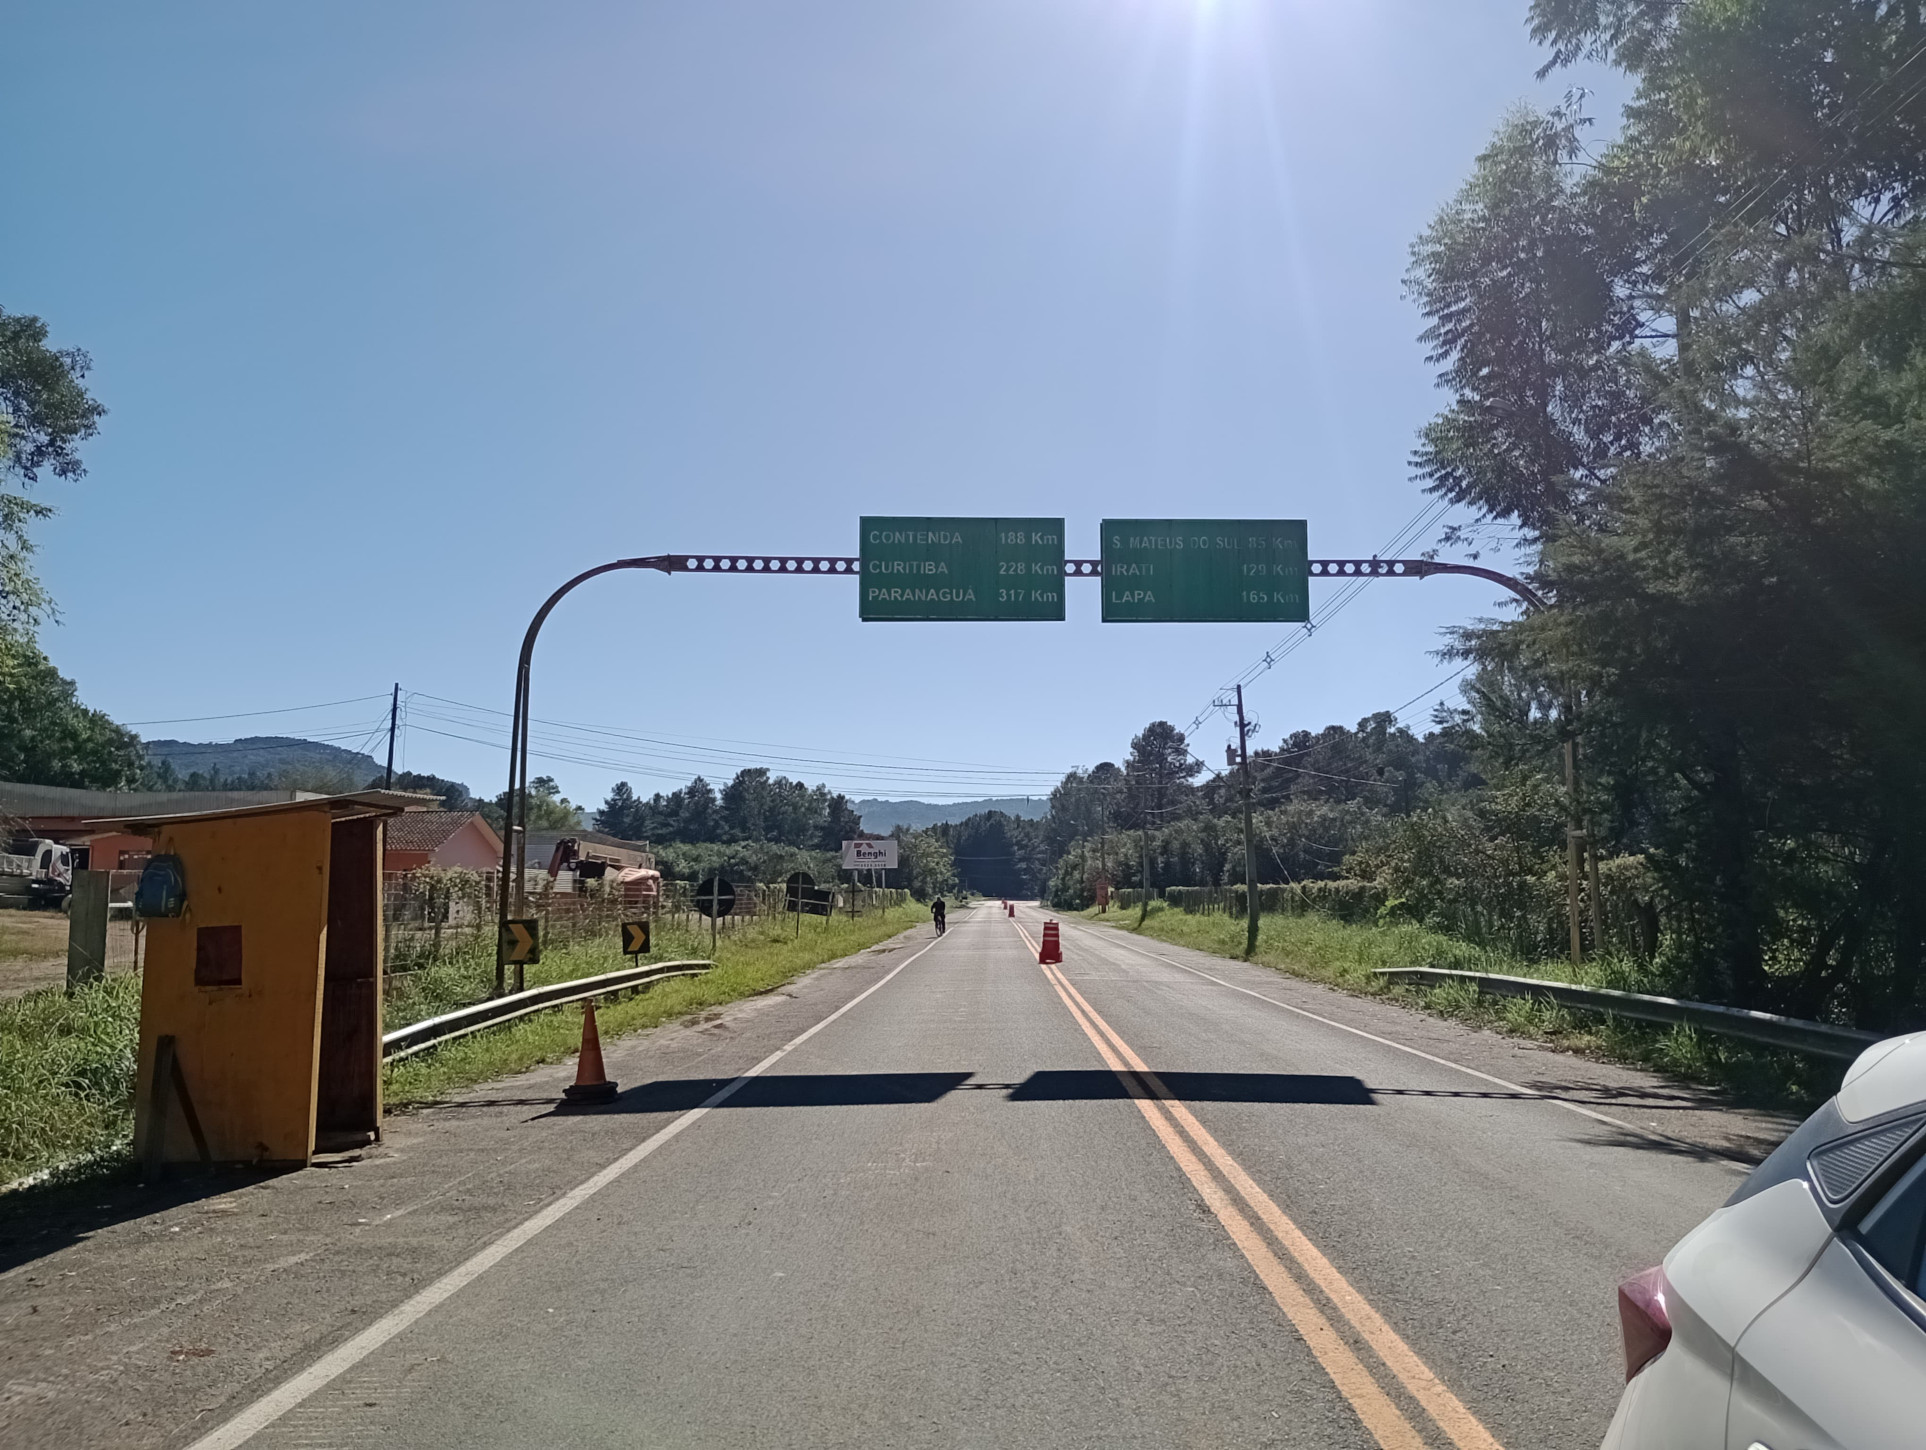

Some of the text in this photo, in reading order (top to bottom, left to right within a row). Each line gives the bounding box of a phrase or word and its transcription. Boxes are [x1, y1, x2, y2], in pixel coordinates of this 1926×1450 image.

[869, 531, 1058, 545] CONTENDA 188 Km
[1129, 537, 1184, 550] MATEUS
[1190, 537, 1210, 550] DO
[1216, 537, 1241, 550] SUL
[1272, 537, 1299, 550] Km
[869, 561, 1058, 575] CURITIBA 228 Km
[1111, 563, 1299, 576] IRATI 129 Km
[868, 586, 1058, 602] PARANAGUÁ 317 Km
[1111, 591, 1300, 604] LAPA 165 Km
[856, 849, 887, 860] Benghi
